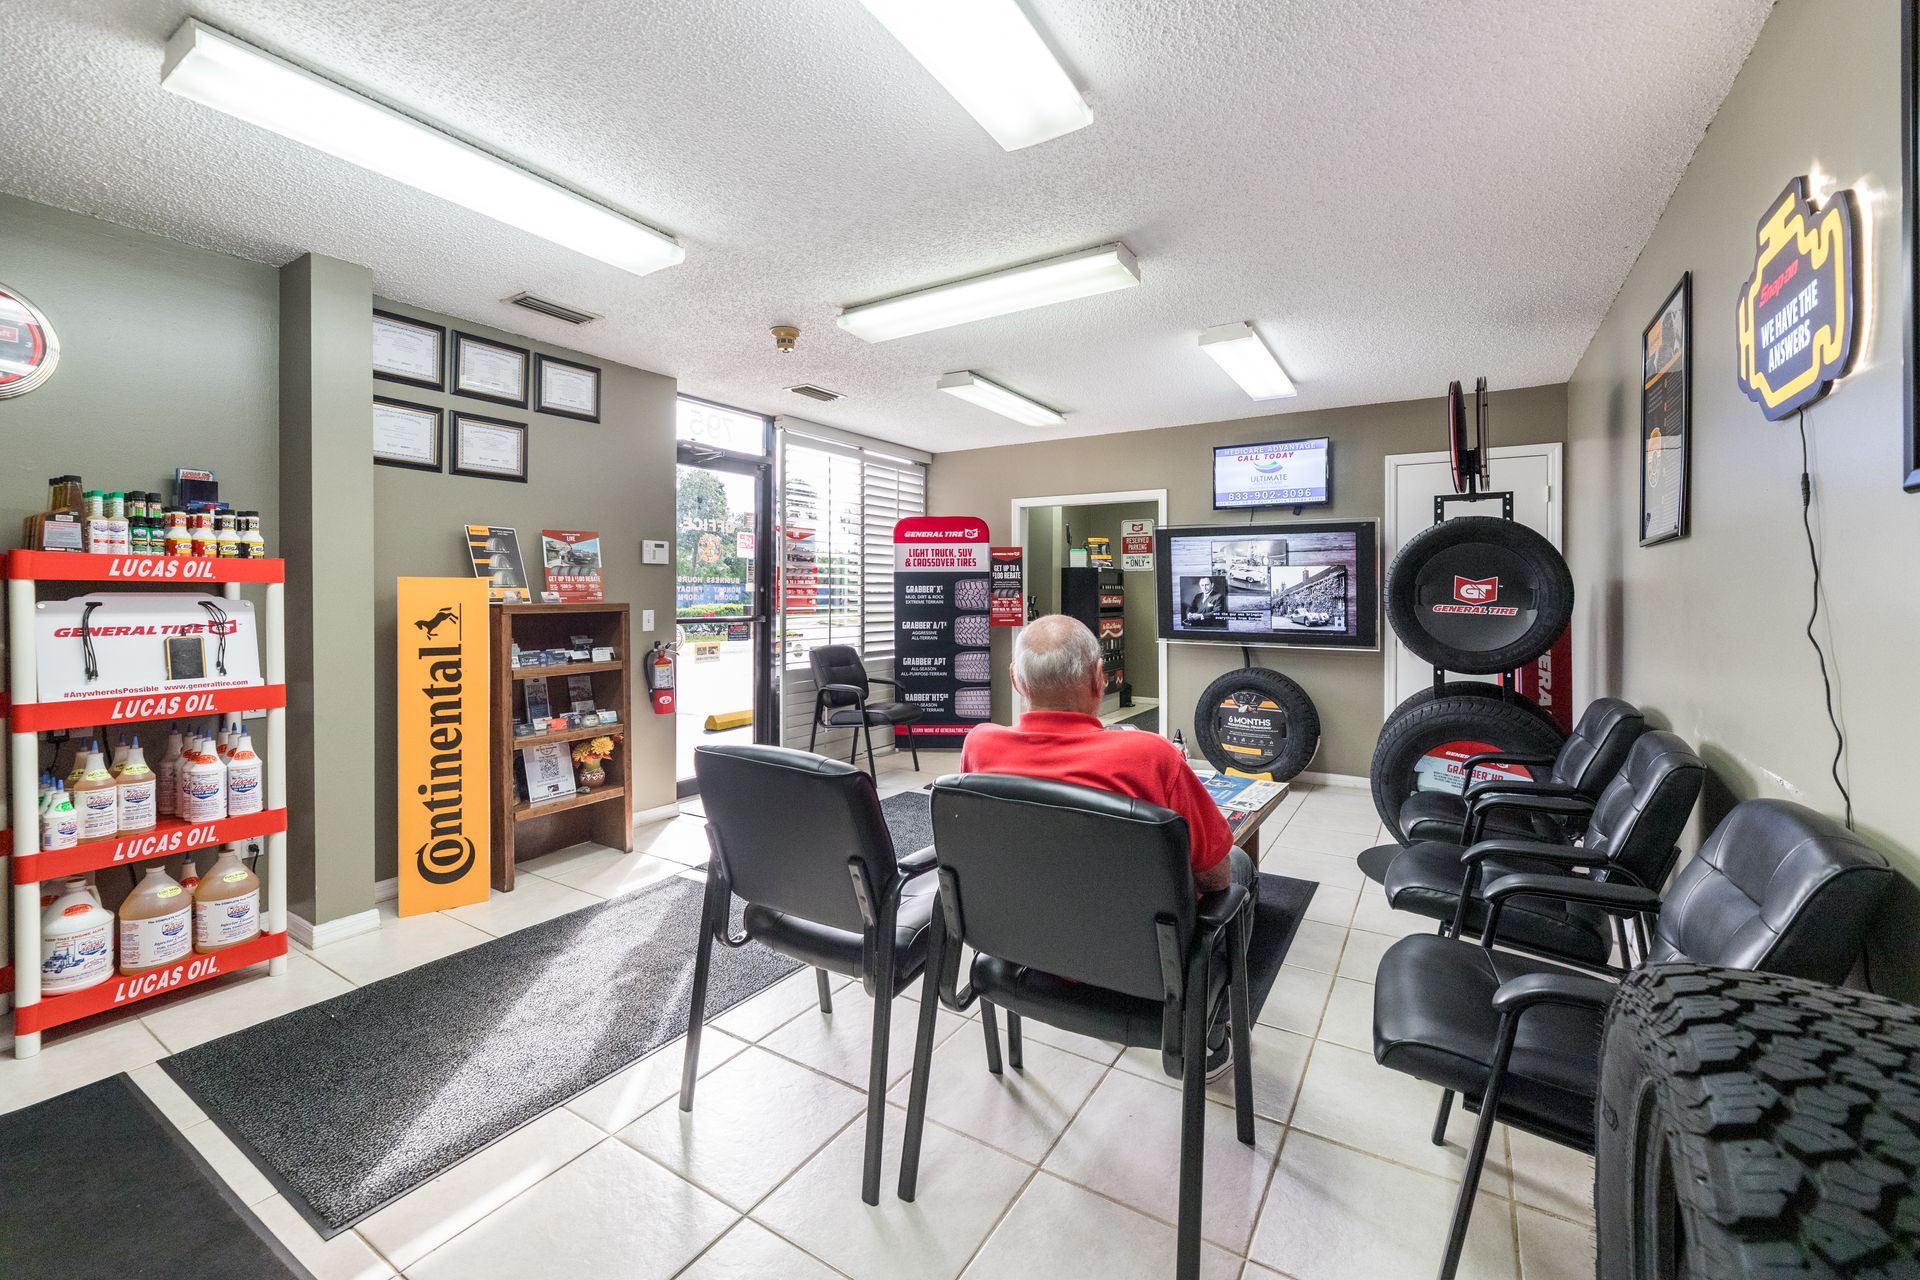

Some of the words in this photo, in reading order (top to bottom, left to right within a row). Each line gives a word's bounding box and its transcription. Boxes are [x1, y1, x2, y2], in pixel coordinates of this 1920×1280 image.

[1759, 258, 1799, 308] Snap-on
[1761, 318, 1775, 349] WE
[1775, 296, 1799, 338] HAVE
[1799, 278, 1818, 318] THE
[1768, 318, 1811, 373] ANSWERS
[1224, 447, 1265, 456] MEDICARE
[1267, 442, 1317, 453] ADVANTAGE
[1237, 454, 1260, 462] CALL
[1264, 452, 1295, 460] TODAY
[1250, 474, 1288, 483] ULTIMATE
[1228, 488, 1312, 501] 833-902-3096
[908, 548, 929, 557] LIGHT
[931, 548, 956, 558] TRUCK,
[957, 548, 973, 557] SUV
[109, 559, 178, 577] LUCAS
[183, 561, 213, 578] OIL
[905, 558, 911, 567] &
[913, 558, 955, 567] CROSSOVER
[957, 558, 977, 567] TIRES
[994, 564, 1002, 572] GET
[1003, 564, 1010, 572] UP
[1130, 559, 1146, 567] ONLY
[905, 585, 934, 593] GRABBER
[1432, 604, 1487, 615] GENERAL
[1488, 606, 1518, 616] TIRE
[54, 625, 157, 638] GENERAL
[161, 624, 205, 635] TIRE
[902, 621, 931, 629] GRABBER
[903, 657, 932, 665] GRABBER
[934, 657, 947, 665] APT
[63, 685, 159, 698] #AnywhereIsPossible
[163, 679, 249, 691] www.generaltire.com
[904, 693, 930, 701] RABBER
[111, 697, 182, 719] LUCAS
[185, 694, 215, 713] OIL
[1228, 715, 1234, 723] 6
[1234, 717, 1271, 726] MONTHS
[417, 643, 476, 885] Continental
[1447, 763, 1487, 780] GRABER
[113, 831, 182, 861] LUCAS
[187, 825, 216, 846] OIL
[114, 961, 184, 1002] LUCAS
[187, 956, 217, 979] OIL
